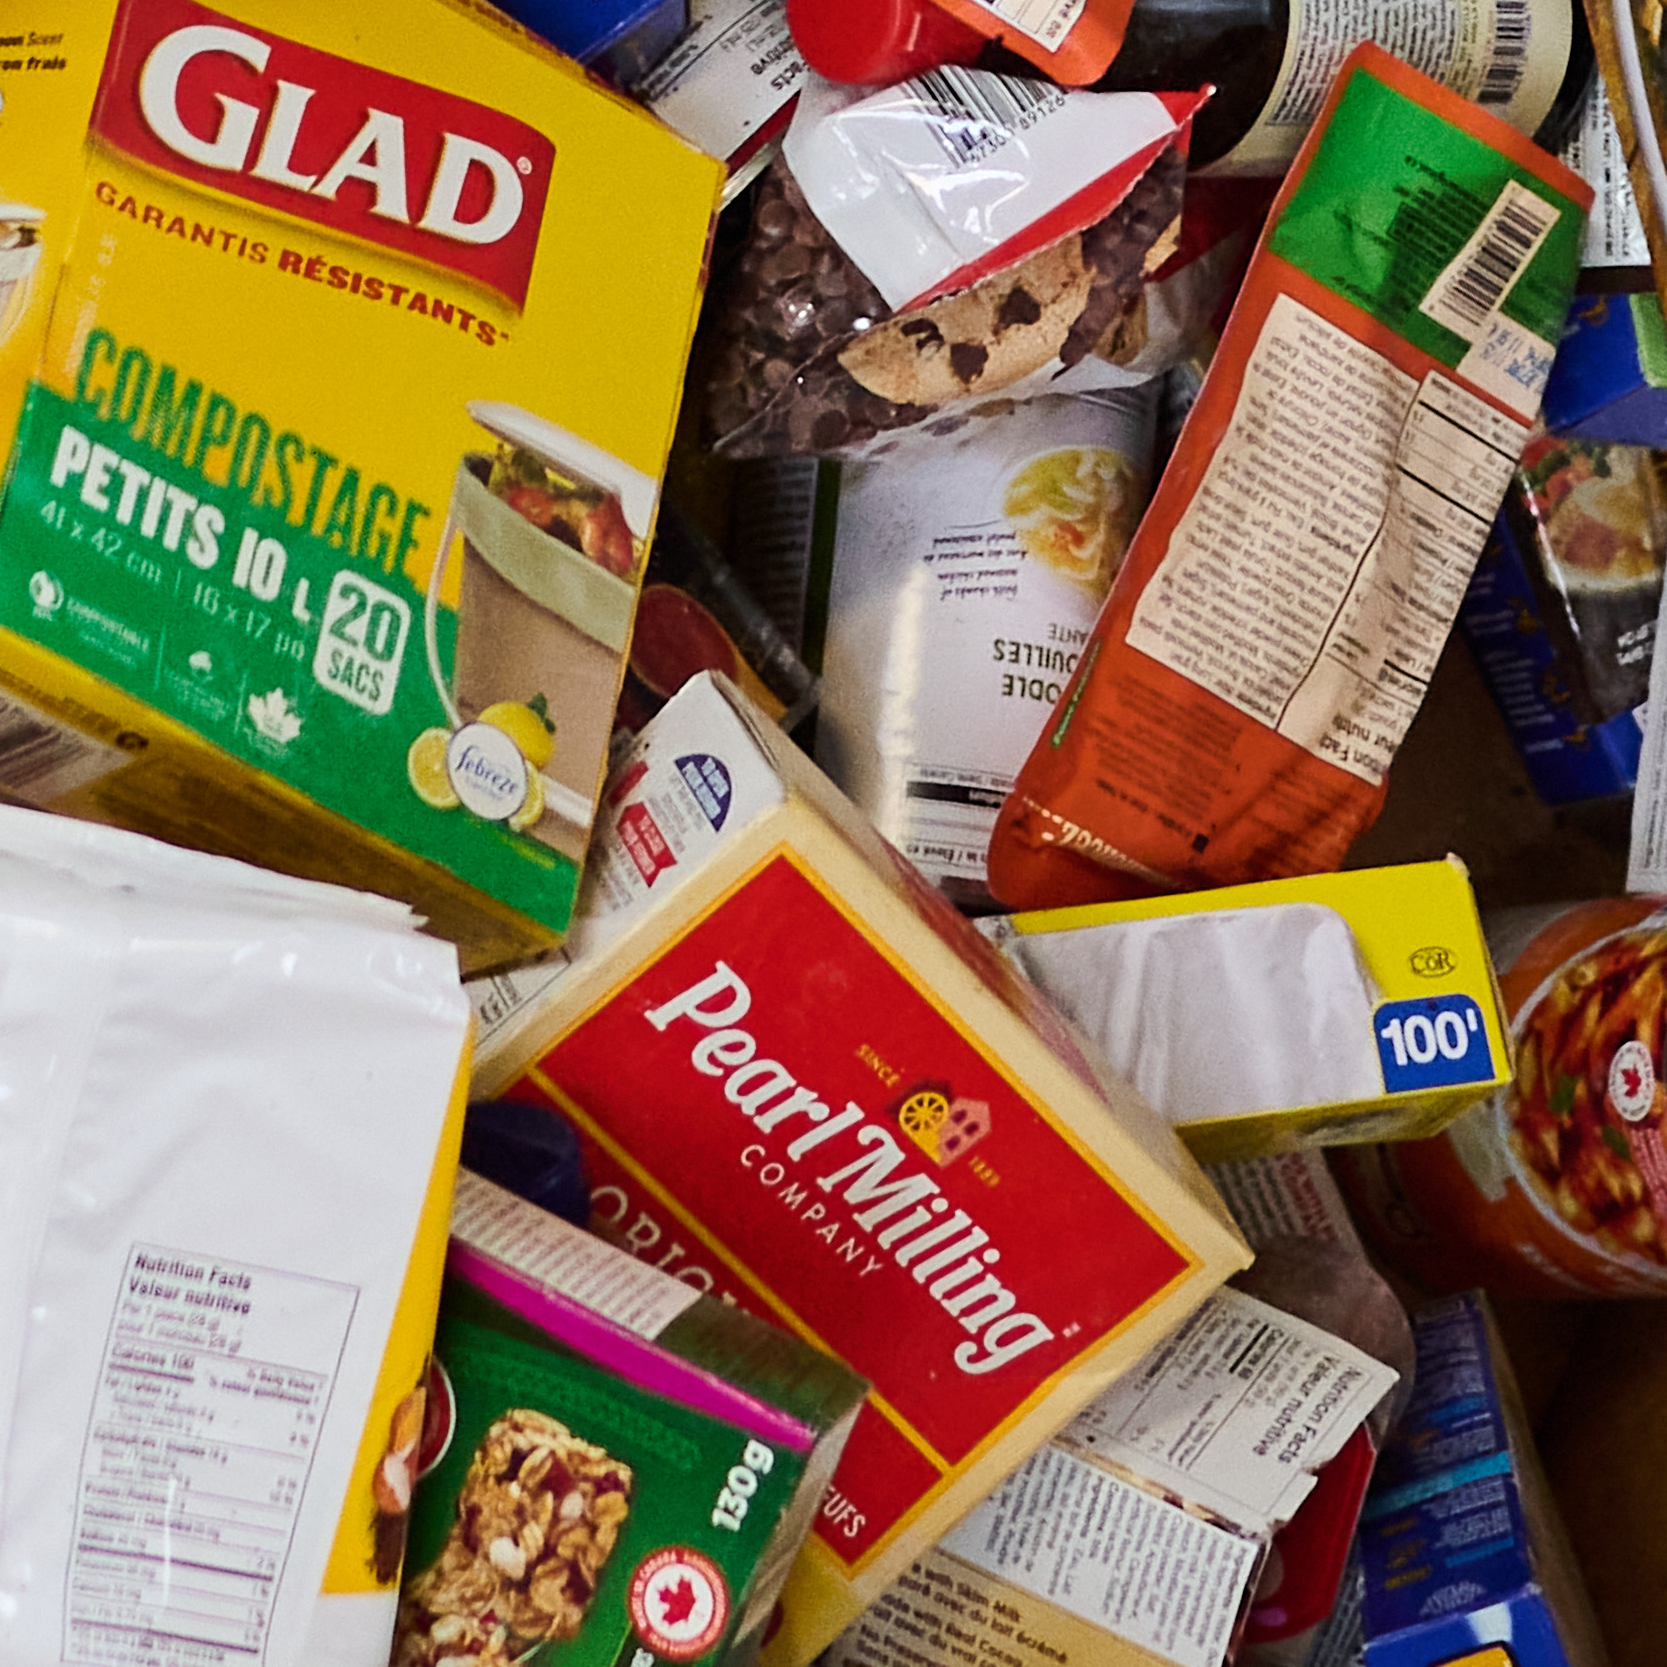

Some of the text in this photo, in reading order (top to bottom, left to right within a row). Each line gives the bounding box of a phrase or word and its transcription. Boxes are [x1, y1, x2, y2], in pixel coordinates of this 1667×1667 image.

[25, 32, 64, 46] Scent
[25, 57, 66, 72] frais
[130, 12, 537, 258] GLAD
[94, 180, 271, 266] GARANTIS
[69, 324, 433, 575] COMPOSTAGE
[45, 424, 320, 623] PETITS 10 L
[38, 498, 66, 530] 41
[68, 519, 85, 540] x
[88, 528, 123, 561] 42
[124, 551, 164, 584] cm
[222, 604, 238, 624] x
[244, 609, 272, 638] 17
[325, 581, 406, 663] 20
[324, 650, 386, 701] SACS
[455, 743, 517, 794] febreze
[854, 1043, 900, 1087] SINCE
[1379, 1008, 1478, 1067] 100'
[644, 959, 1056, 1372] Pearl Milling
[735, 1140, 884, 1283] COMPANY
[128, 1275, 251, 1314] Valeur nutritive
[134, 1252, 252, 1290] Nutrition Facts
[1252, 1354, 1338, 1456] Valeur nutritive
[1277, 1366, 1360, 1464] Nutrition Facts
[708, 1438, 778, 1535] 130g
[924, 1567, 1021, 1623] with Skim Milk
[931, 1590, 1069, 1666] avec du lait écrémé
[860, 1624, 880, 1643] No
[893, 1615, 978, 1666] avec du vrai
[911, 1604, 1023, 1667] with Real Cocoa
